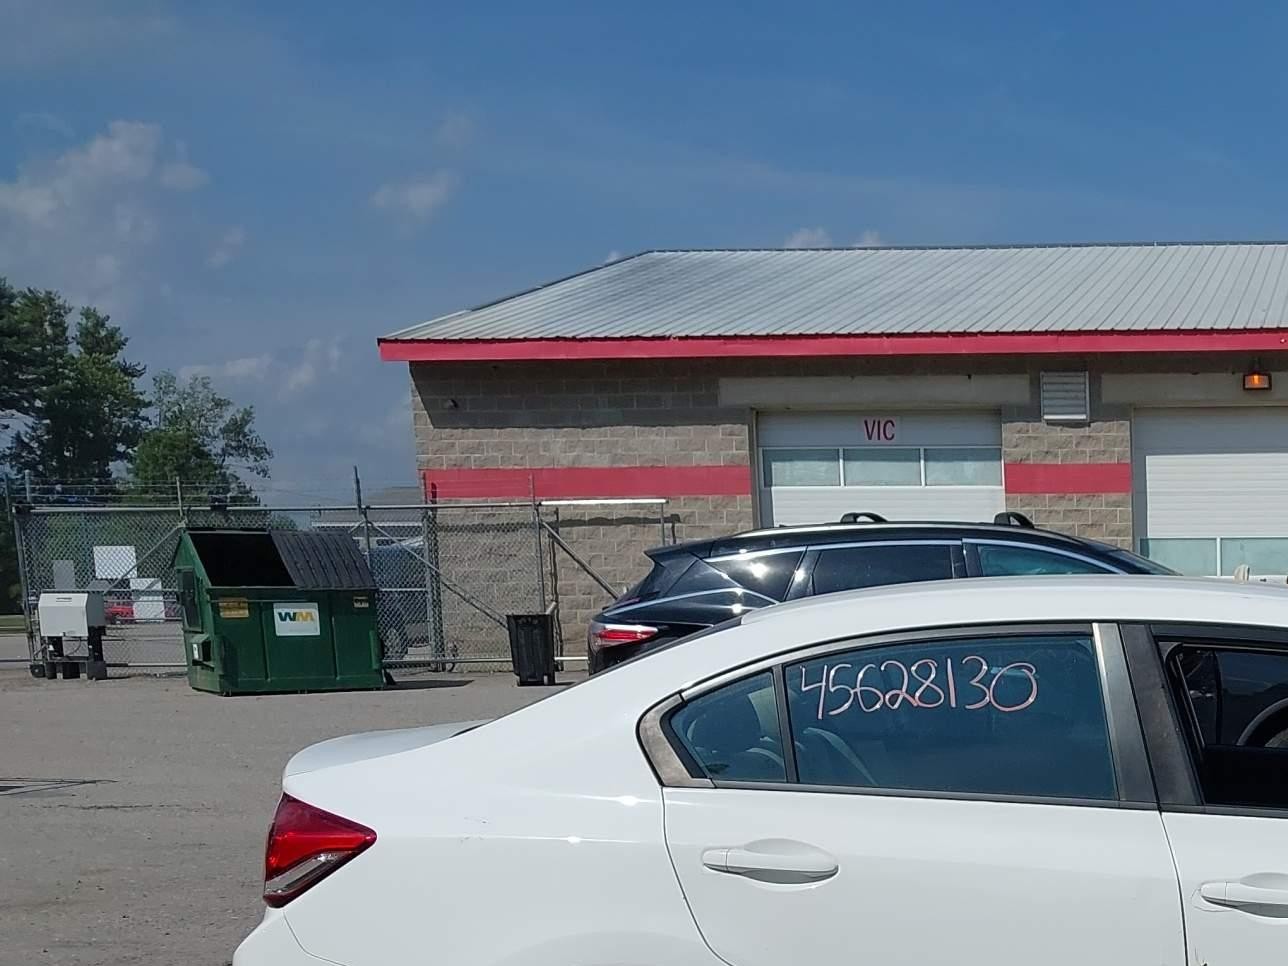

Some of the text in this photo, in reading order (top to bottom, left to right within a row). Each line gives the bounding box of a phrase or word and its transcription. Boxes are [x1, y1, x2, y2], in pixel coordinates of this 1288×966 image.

[864, 419, 896, 441] VIC
[277, 611, 315, 622] WM
[800, 656, 1038, 720] 45628130
